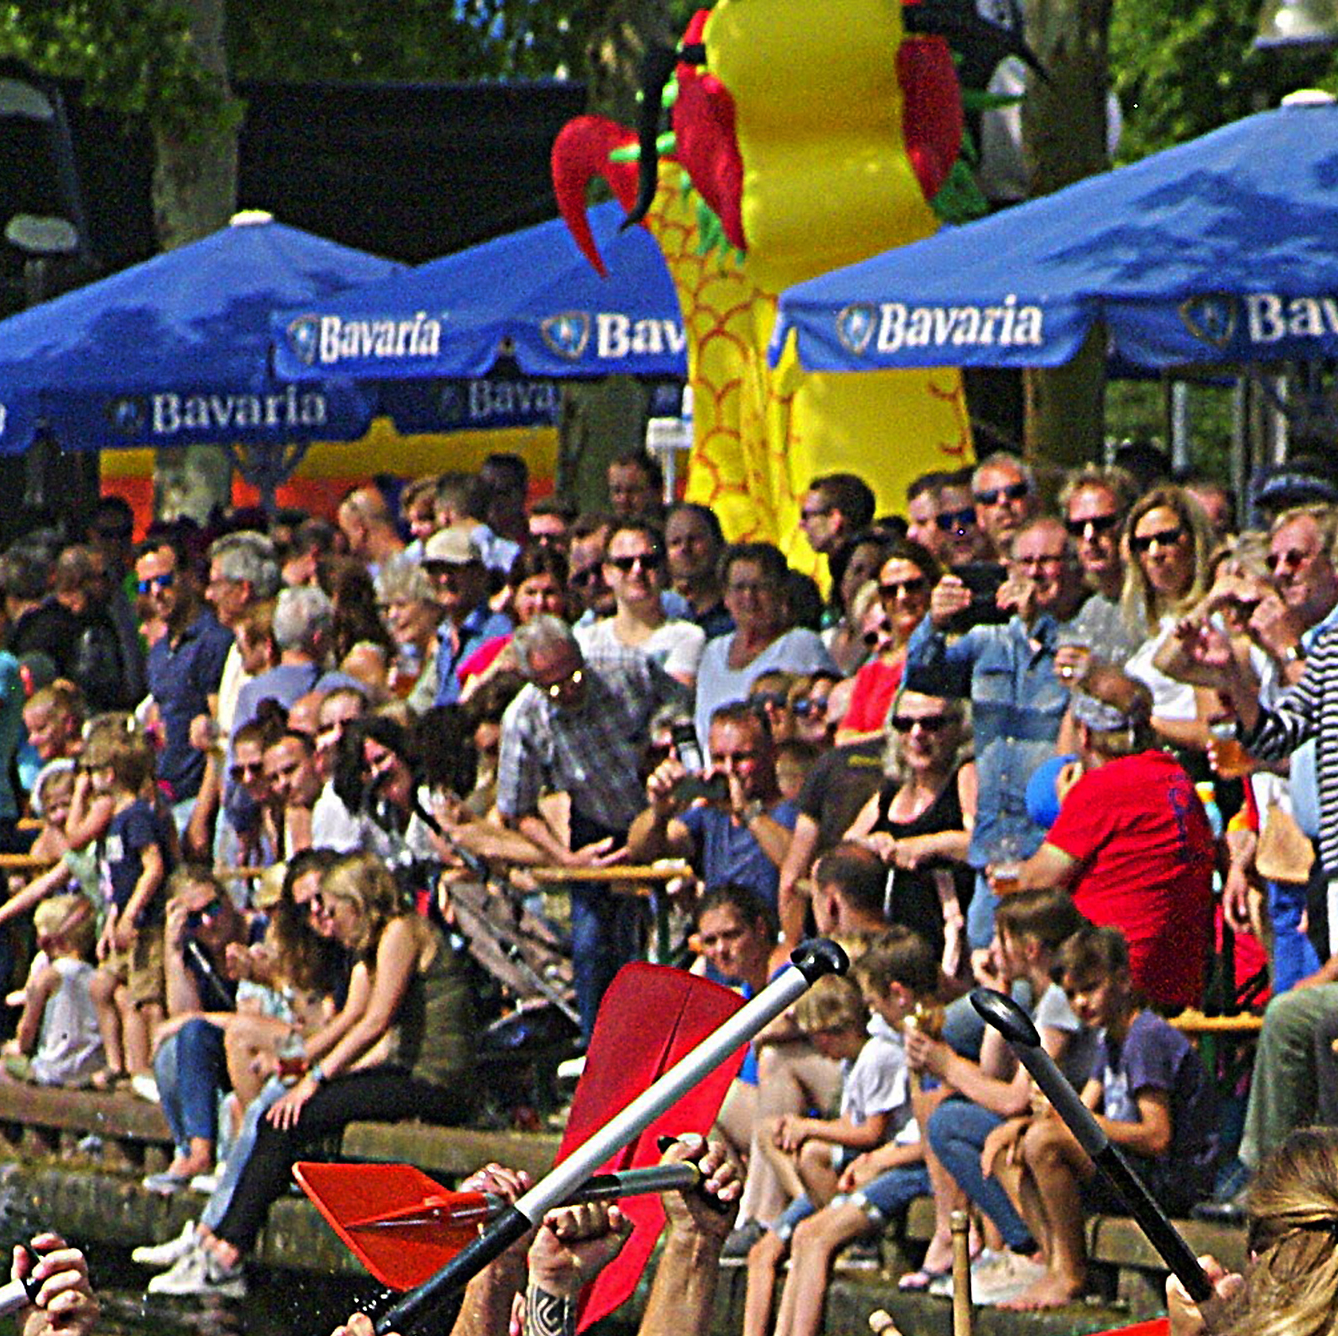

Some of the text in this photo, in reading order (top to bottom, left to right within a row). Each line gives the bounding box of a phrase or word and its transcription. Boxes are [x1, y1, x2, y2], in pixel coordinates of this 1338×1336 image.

[320, 311, 440, 363] Bavaria
[876, 294, 1043, 351] Bavaria
[153, 384, 325, 433] Bavaria
